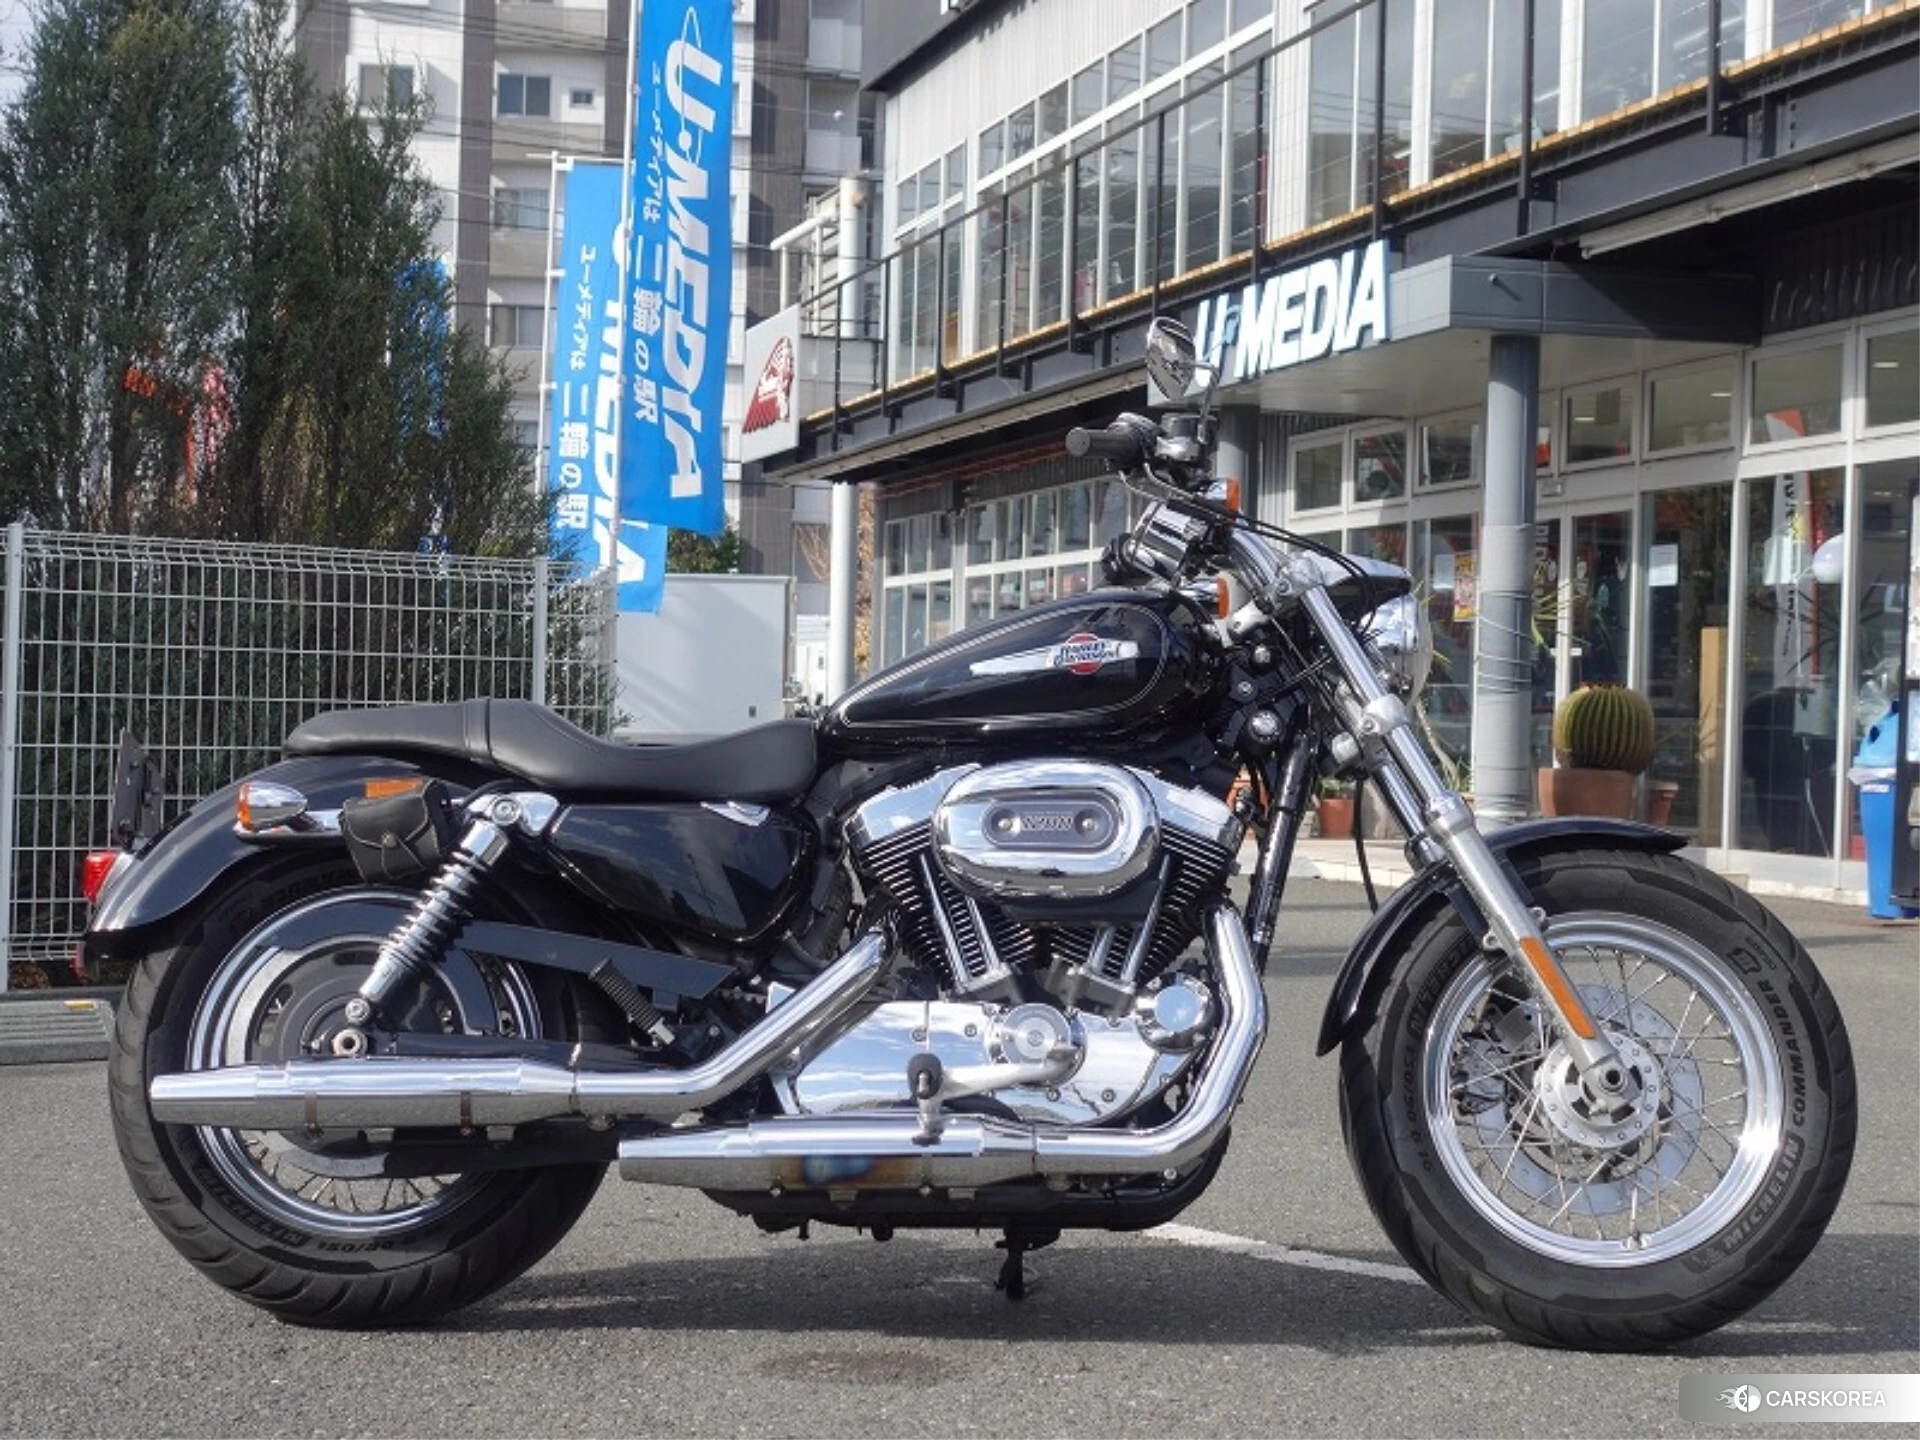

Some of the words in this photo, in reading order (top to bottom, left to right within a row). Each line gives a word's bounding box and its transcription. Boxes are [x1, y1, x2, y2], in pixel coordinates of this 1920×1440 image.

[570, 243, 597, 371] ユーメディアは
[632, 235, 663, 425] 二輪の駅
[556, 381, 590, 530] 二輪の駅
[1758, 979, 1806, 1127] COMMANDER
[1723, 1138, 1799, 1250] MICHELIN
